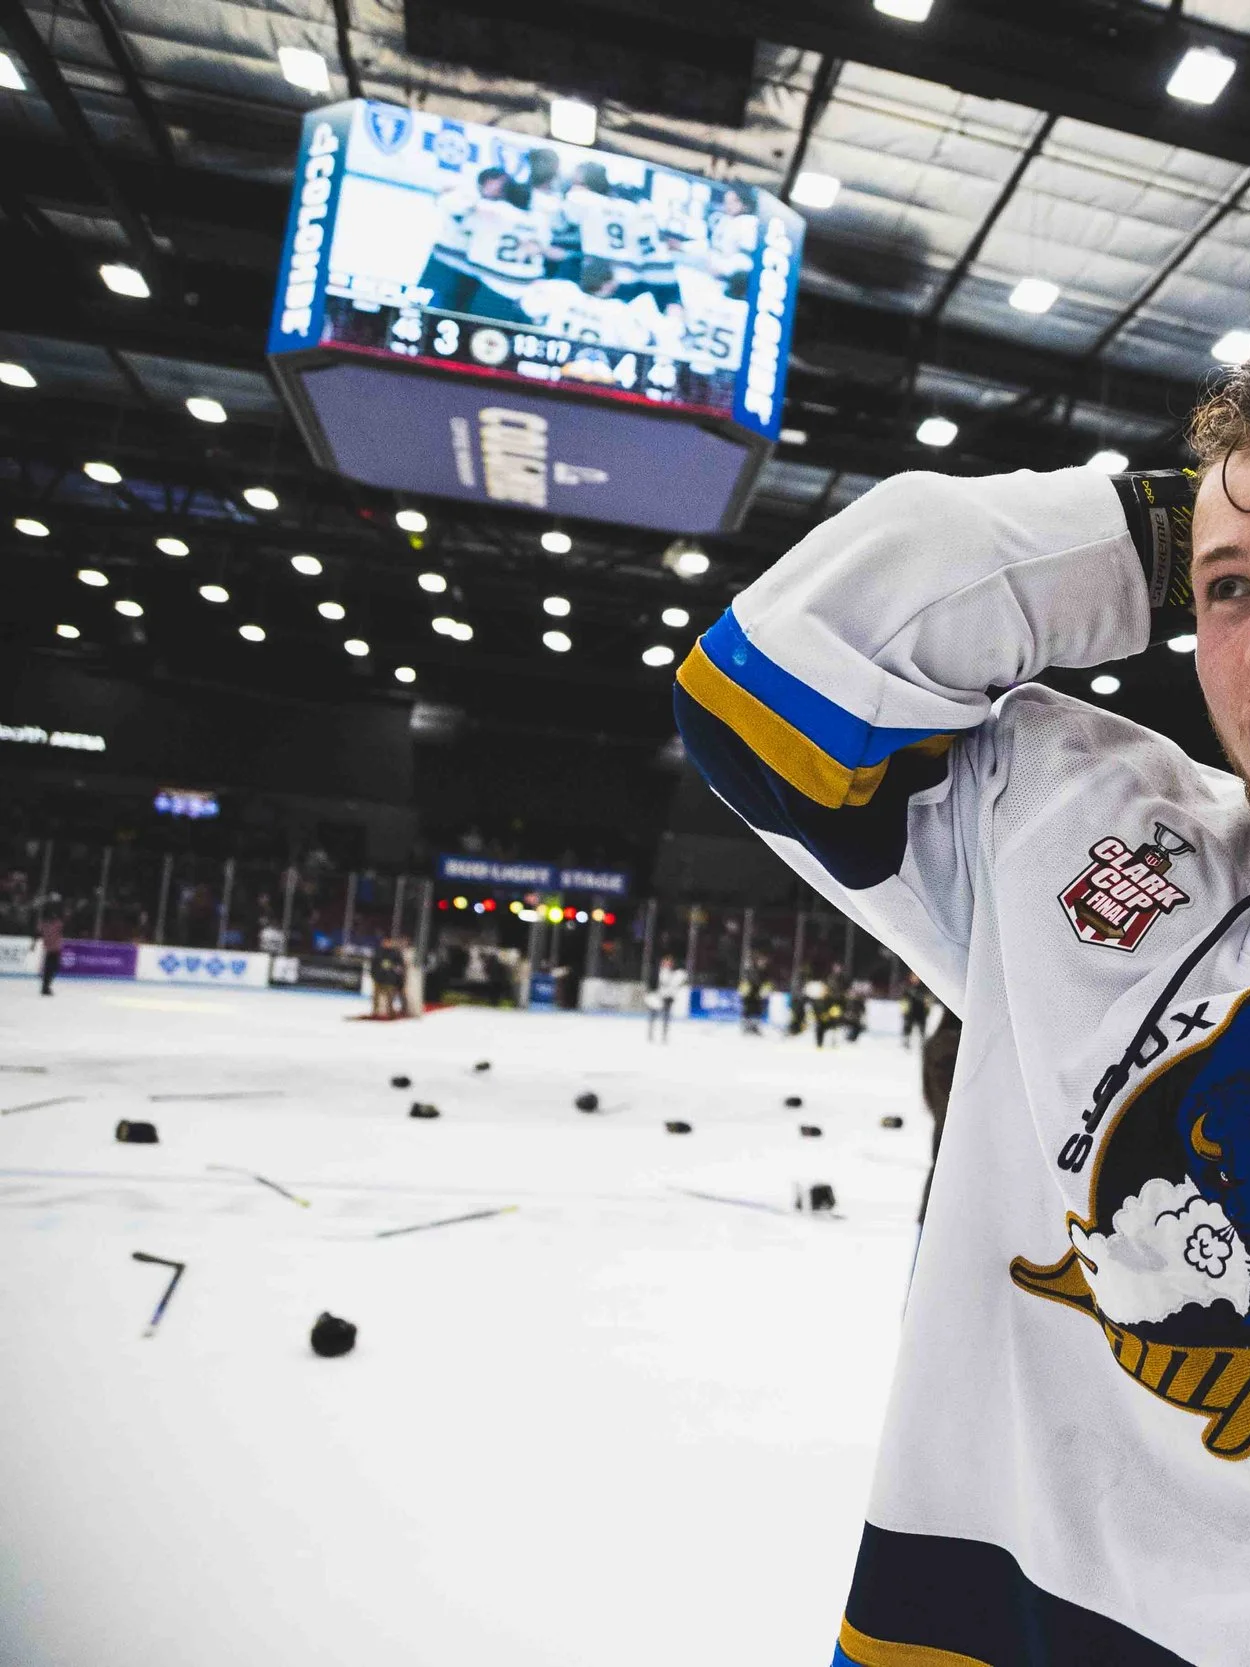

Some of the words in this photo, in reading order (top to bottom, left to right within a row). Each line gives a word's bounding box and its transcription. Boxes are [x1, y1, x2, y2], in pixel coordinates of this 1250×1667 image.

[434, 319, 460, 356] 3
[612, 353, 637, 389] 4
[1091, 867, 1154, 909] CUP
[1093, 839, 1185, 908] CLARK
[1086, 890, 1129, 926] FINAL
